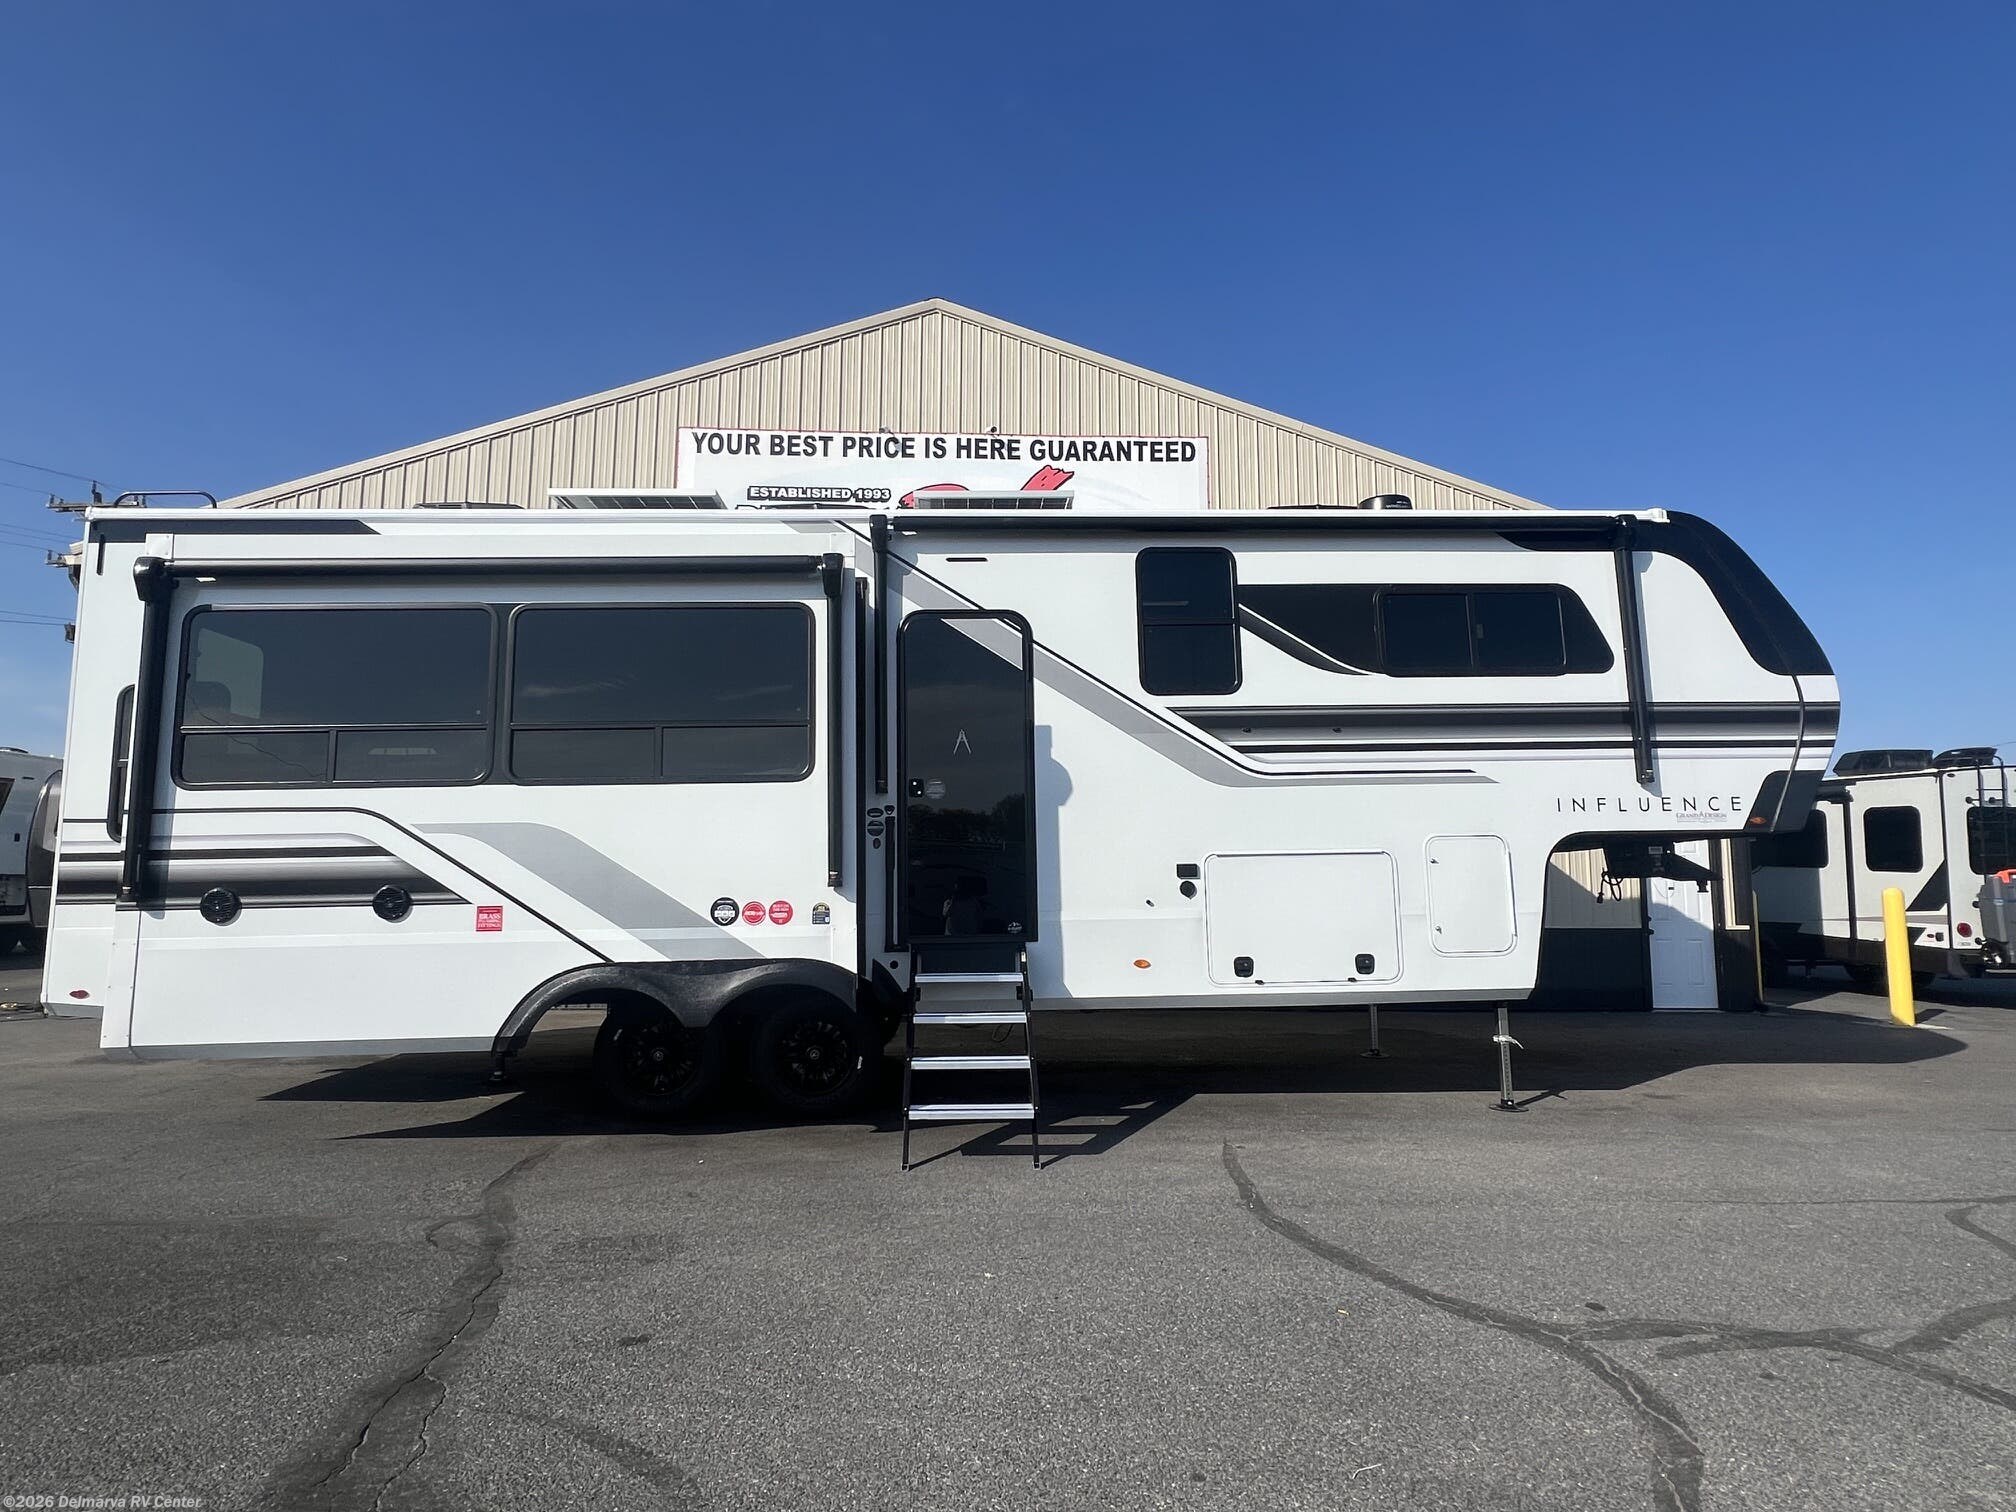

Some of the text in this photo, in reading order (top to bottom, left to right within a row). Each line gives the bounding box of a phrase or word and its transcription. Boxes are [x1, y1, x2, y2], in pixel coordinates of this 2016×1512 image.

[692, 431, 1197, 463] YOUR BEST PRICE IS HERE GUARANTEED
[749, 486, 891, 501] ESTABLISHED 1993
[1556, 796, 1743, 812] INFLUENCE
